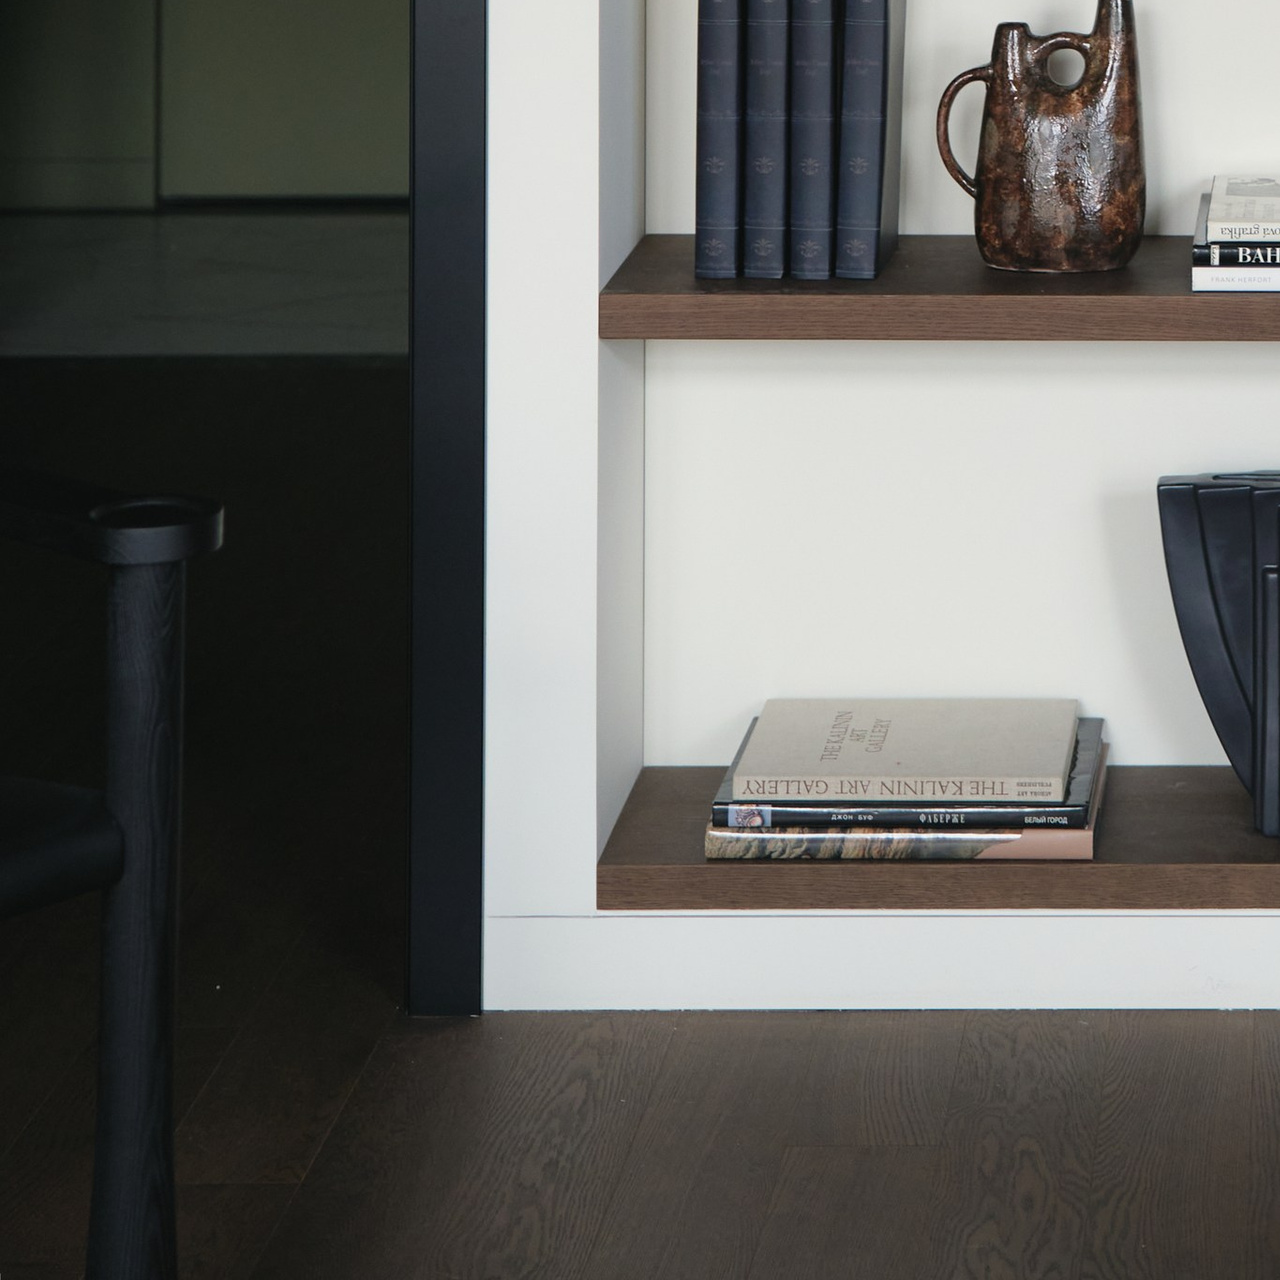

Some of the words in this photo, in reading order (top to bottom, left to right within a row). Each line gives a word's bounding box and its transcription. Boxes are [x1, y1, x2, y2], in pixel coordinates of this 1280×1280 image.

[1220, 223, 1260, 239] grafika
[741, 778, 829, 796] GALLERY
[835, 779, 871, 796] ART
[880, 780, 964, 796] KALININ
[970, 780, 1009, 796] THE
[831, 813, 854, 821] ДЖОН
[919, 813, 966, 824] ФАБЕРЖЕ
[1024, 815, 1047, 824] БЕЛЫЙ
[1047, 816, 1069, 824] ГОРОД
